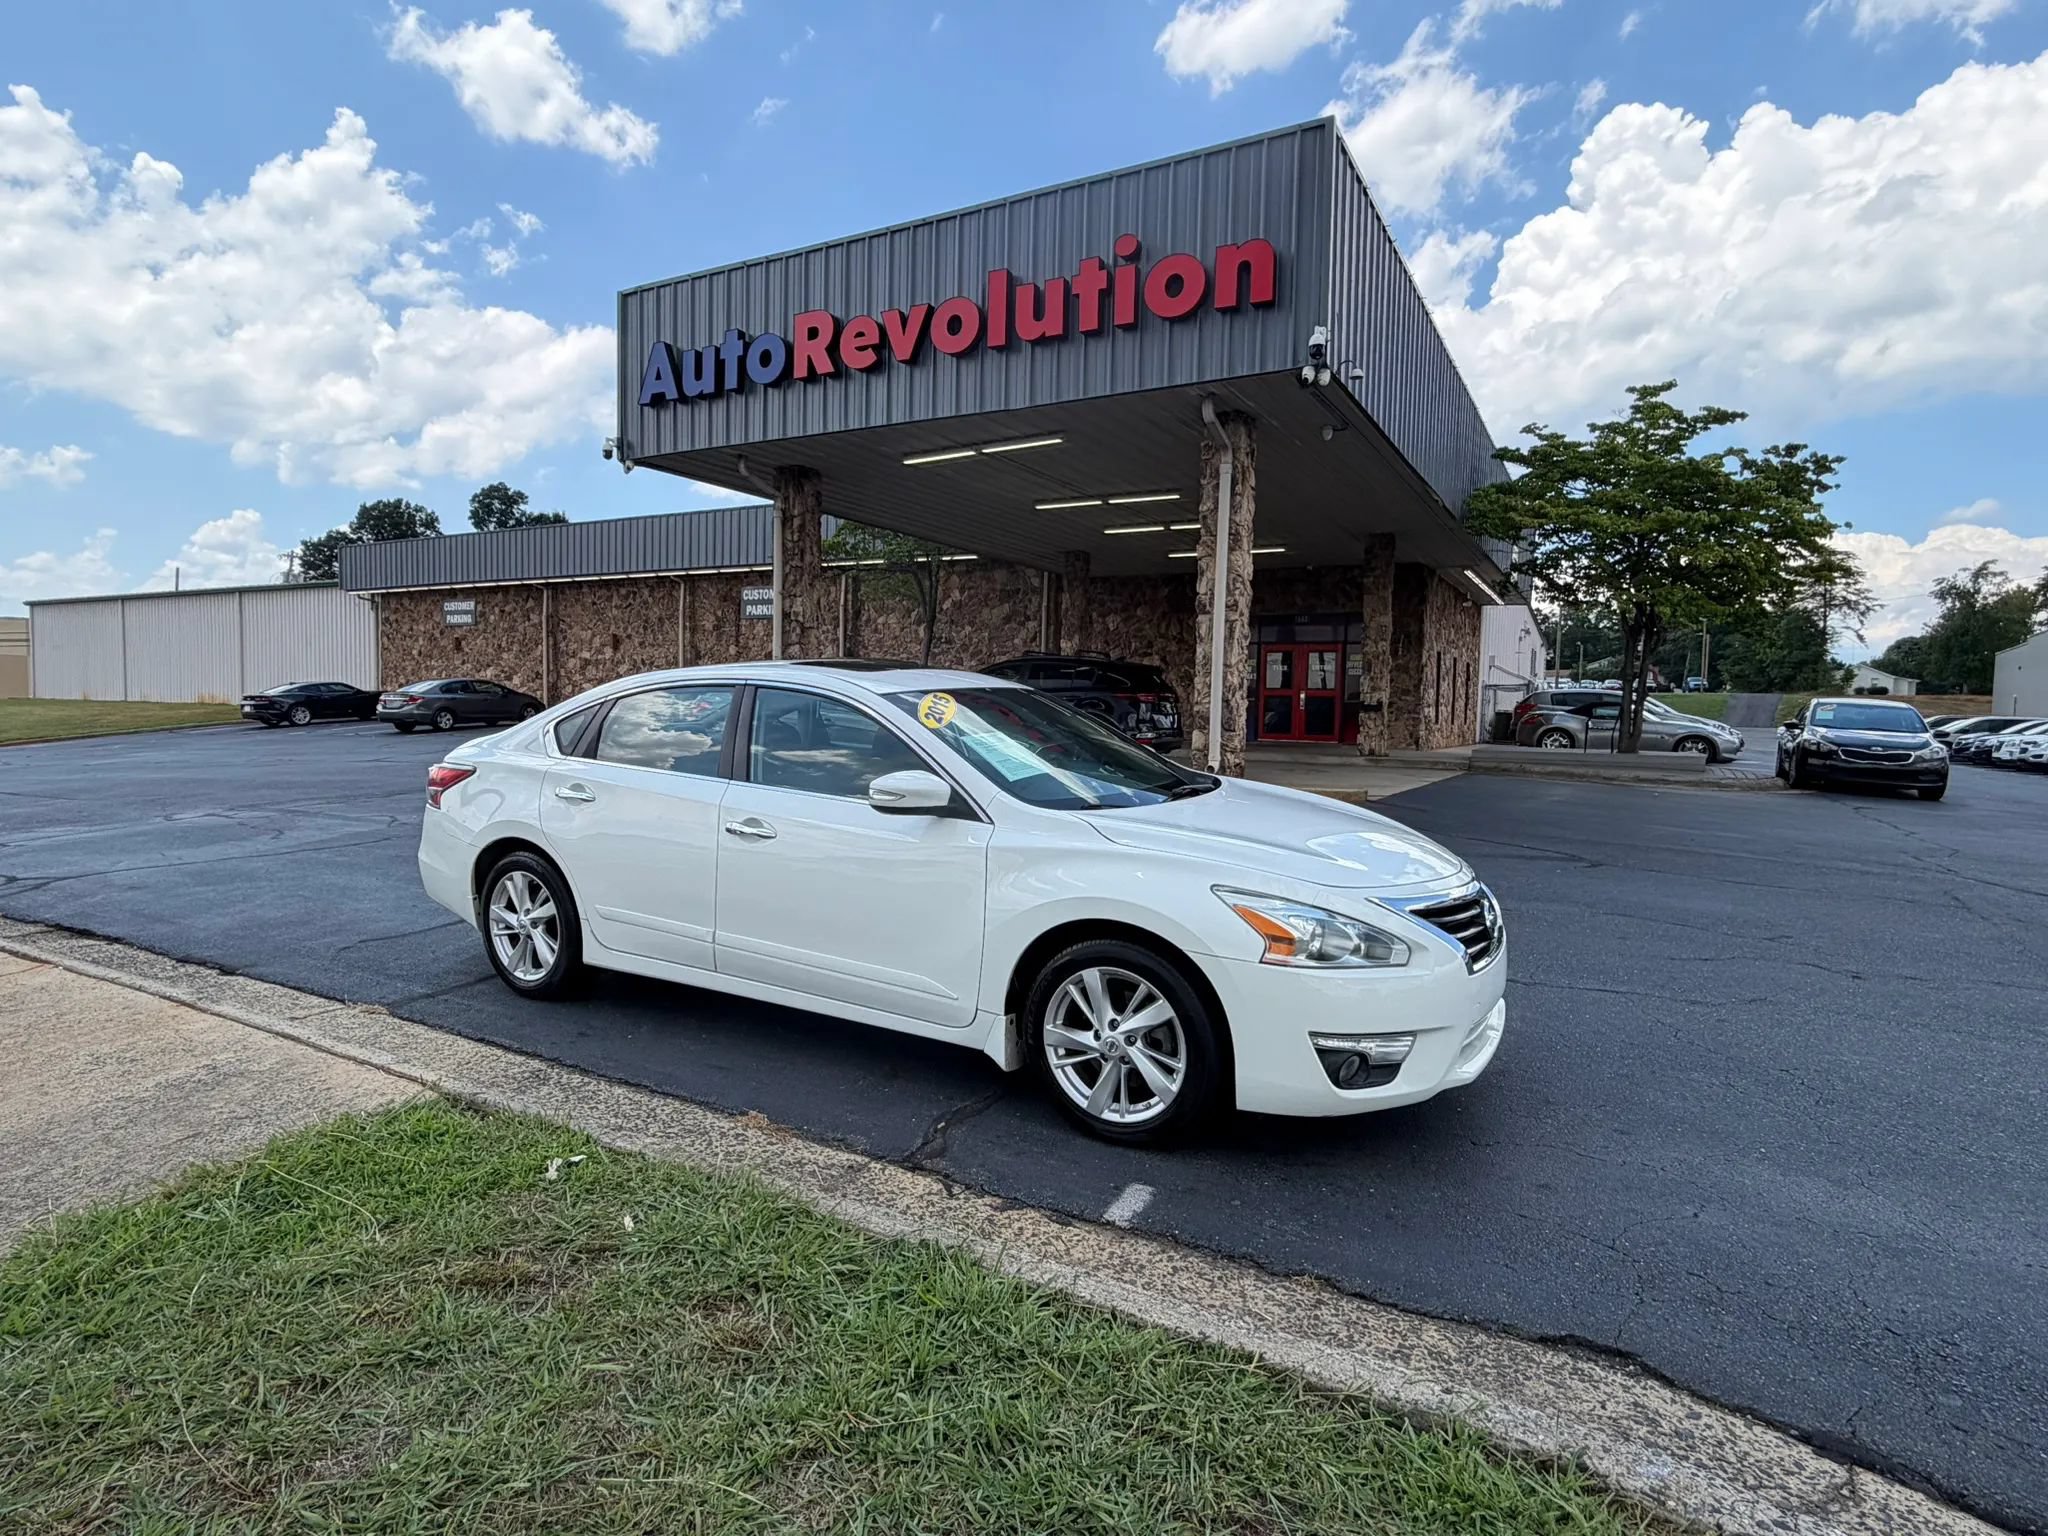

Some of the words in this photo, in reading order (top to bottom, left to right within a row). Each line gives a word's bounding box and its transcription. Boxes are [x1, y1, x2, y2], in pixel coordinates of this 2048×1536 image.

[444, 601, 475, 611] CUSTOMER
[746, 604, 774, 616] PARKI
[446, 614, 472, 623] PARKING
[924, 694, 951, 724] 2015
